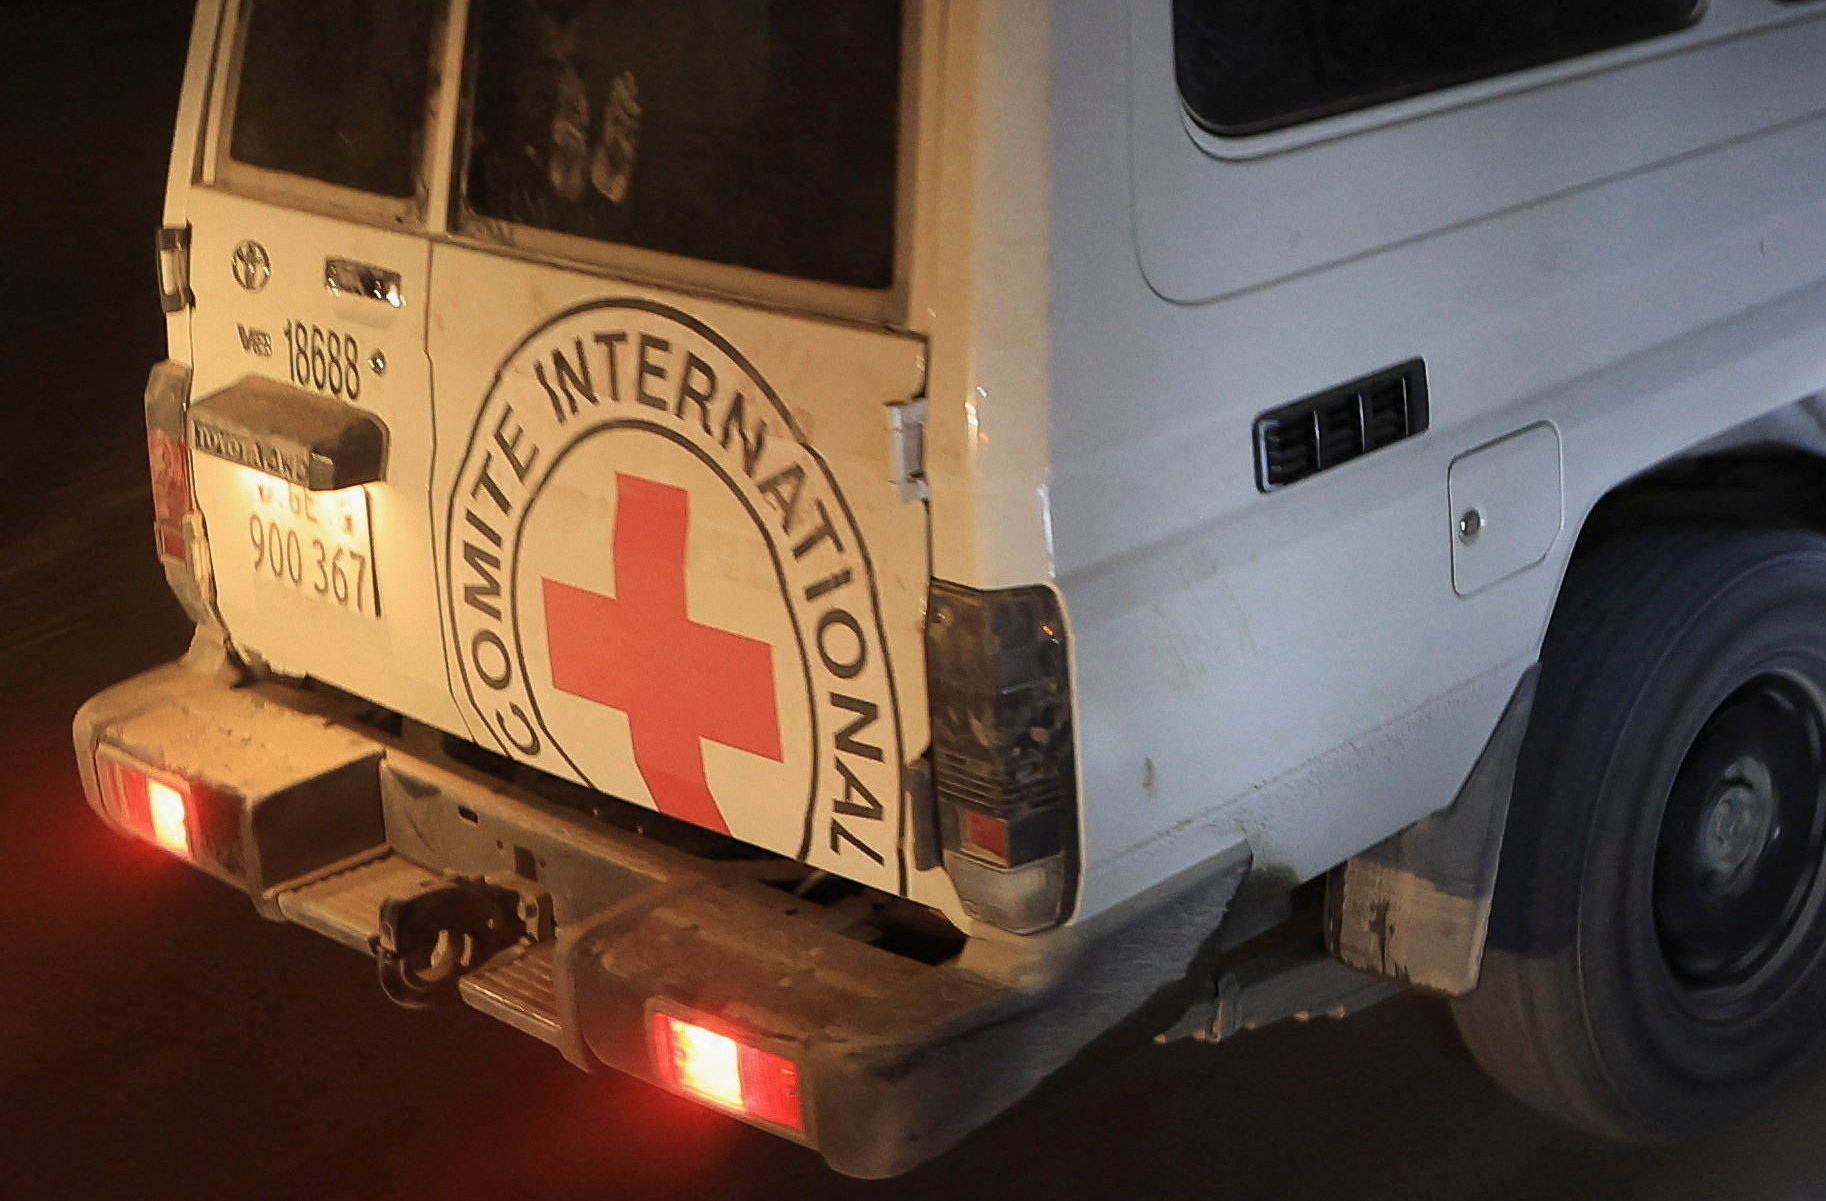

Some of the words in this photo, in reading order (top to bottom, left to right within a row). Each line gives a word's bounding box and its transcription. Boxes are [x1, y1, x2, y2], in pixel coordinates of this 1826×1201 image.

[284, 318, 360, 401] 18688
[249, 513, 302, 587] 900
[312, 538, 366, 612] 367
[463, 401, 541, 756] COMITE
[533, 330, 886, 867] INTERNATIONAL
